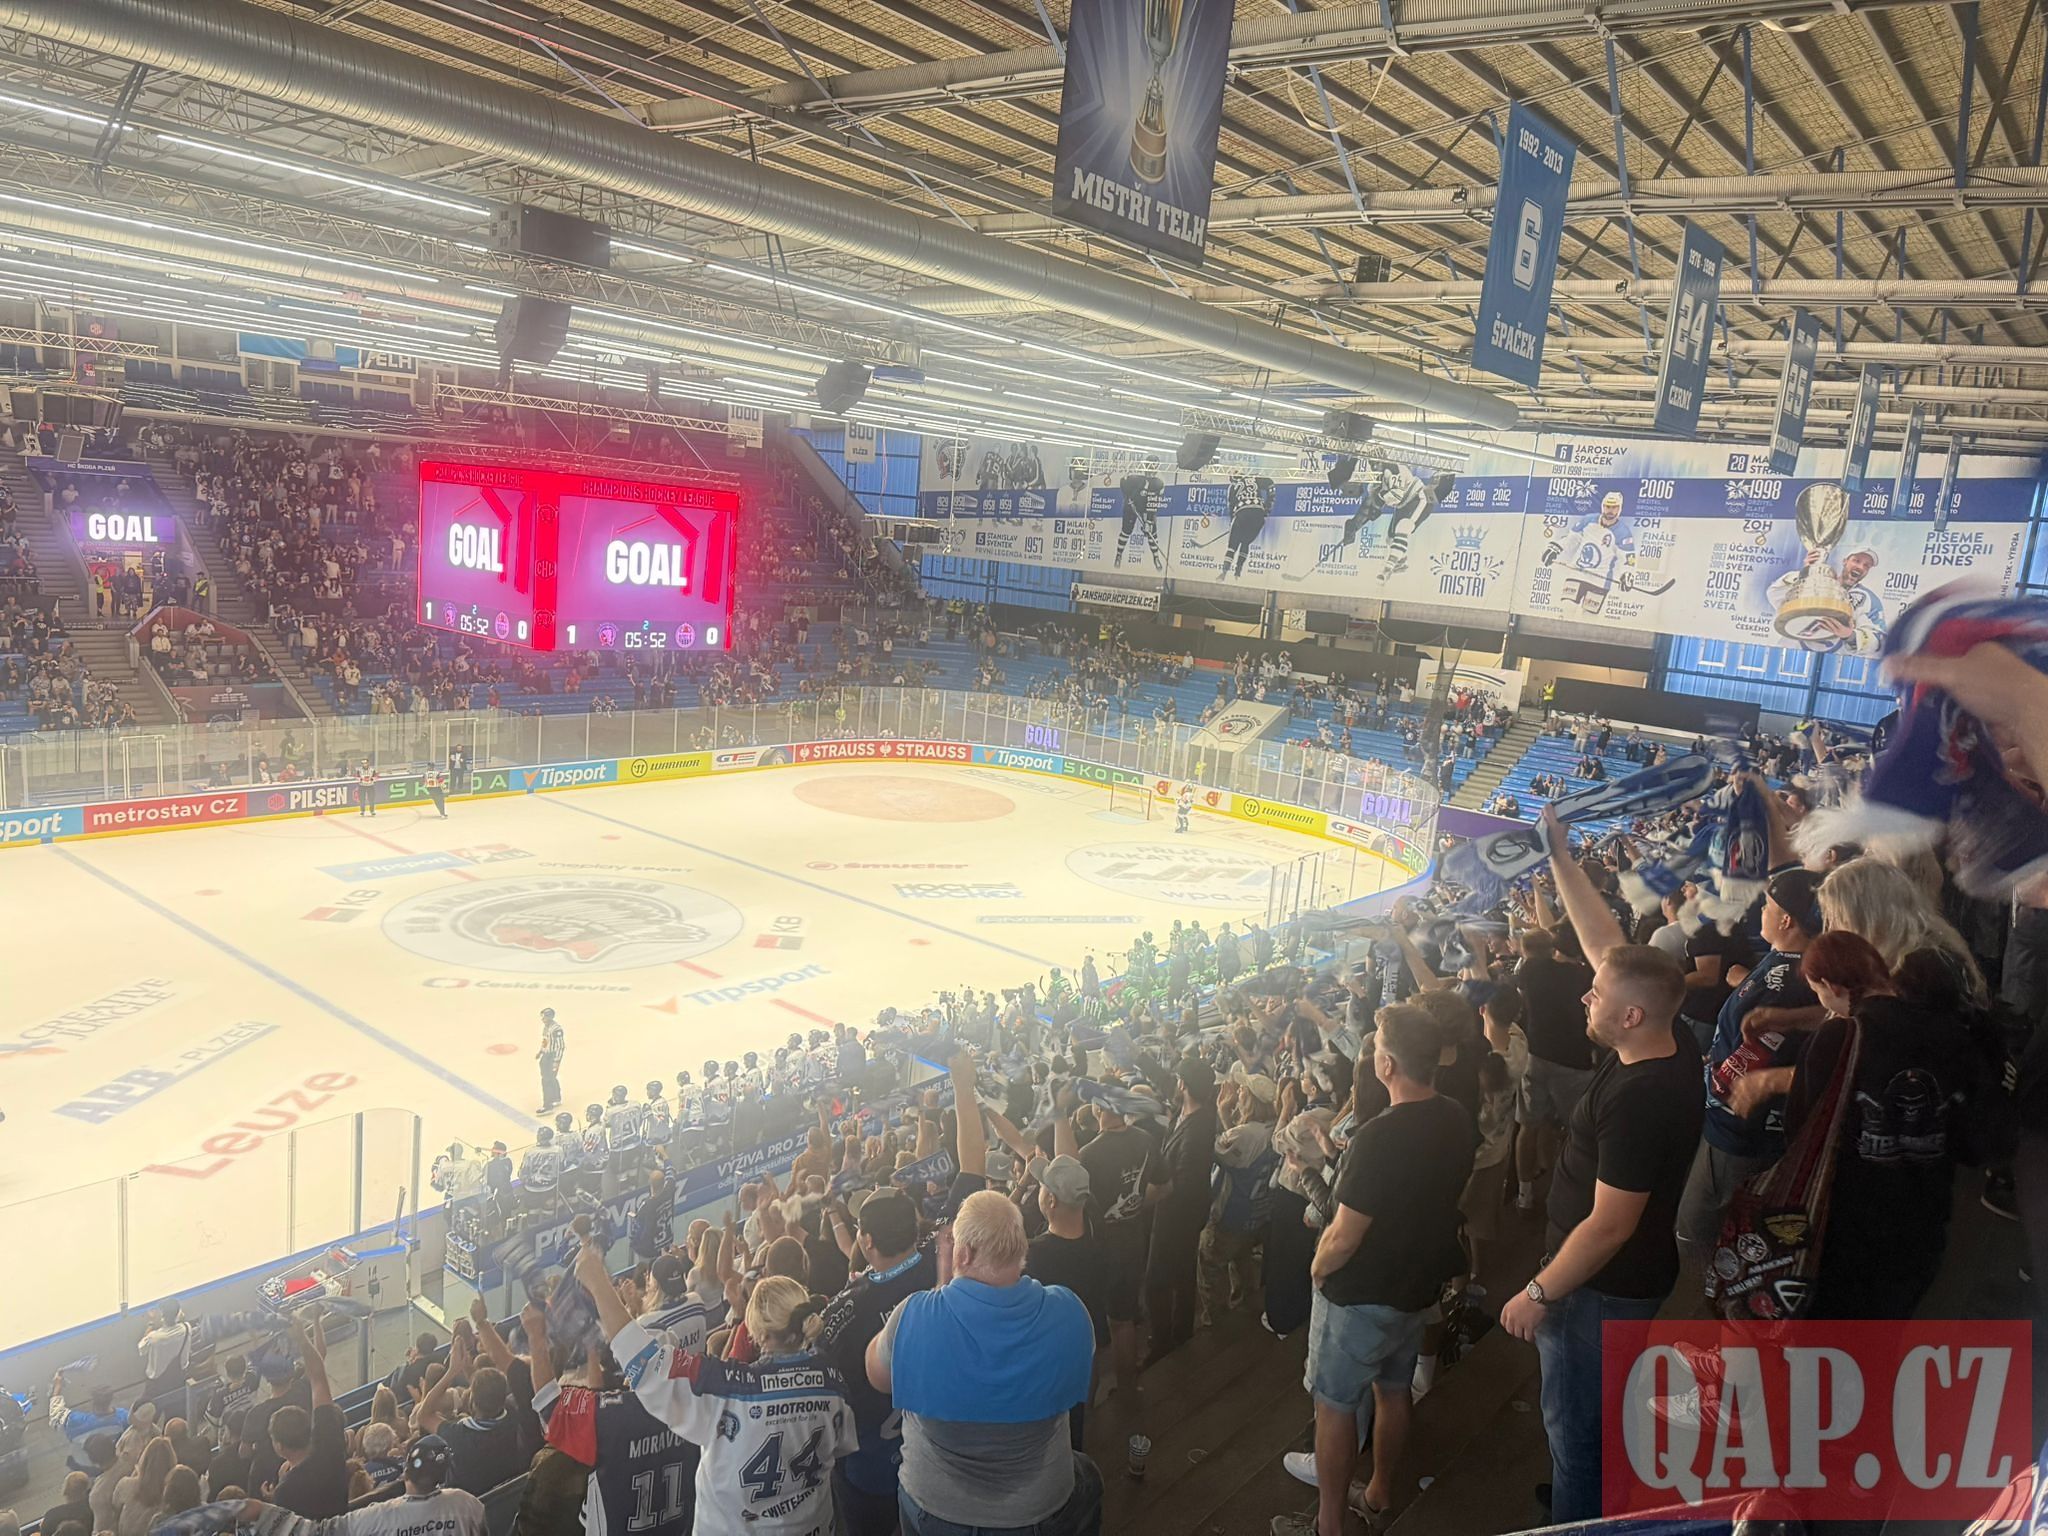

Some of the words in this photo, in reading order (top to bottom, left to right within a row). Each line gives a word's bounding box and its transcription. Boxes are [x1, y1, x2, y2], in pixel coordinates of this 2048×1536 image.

[1518, 127, 1540, 159] 1992
[1543, 145, 1564, 176] 2013
[1072, 166, 1151, 227] MISTŘI
[1156, 200, 1205, 248] TELH
[1513, 198, 1542, 292] 6
[1491, 313, 1536, 361] ŠPAČEK
[1573, 453, 1613, 466] ŠPAČEK
[1575, 445, 1628, 456] JAROSLAV
[1729, 454, 1747, 472] 28
[583, 482, 641, 500] CHAMPIONS
[682, 493, 715, 506] LEAGUE
[1312, 494, 1362, 506] MISTROVSTVÍ
[1548, 478, 1577, 499] 1998
[1639, 479, 1675, 500] 2006
[1749, 480, 1782, 500] 1998
[1863, 493, 1889, 510] 2016
[89, 512, 158, 543] GOAL
[1543, 515, 1569, 527] ZOH
[1633, 518, 1661, 529] ZOH
[1743, 520, 1772, 532] ZOH
[1642, 530, 1677, 543] FINÁLE
[449, 523, 504, 573] GOAL
[1639, 545, 1663, 559] 2006
[1729, 542, 1760, 554] ÚČAST
[1923, 543, 1993, 555] HISTORII
[606, 539, 687, 587] GOAL
[1450, 551, 1481, 572] 2013
[1725, 562, 1754, 572] SVĚTA
[1930, 555, 1973, 567] DNES
[1439, 572, 1486, 598] MISTŘI
[1706, 570, 1742, 591] 2005
[1885, 572, 1918, 590] 2004
[1703, 599, 1737, 611] SVĚTA
[1705, 588, 1739, 600] MISTR
[426, 601, 432, 620] 1
[517, 620, 528, 640] 0
[566, 624, 576, 644] 1
[624, 631, 666, 648] 05:52
[706, 626, 718, 645] 0
[1025, 724, 1061, 752] GOAL
[813, 742, 876, 759] STRAUSS
[896, 743, 967, 763] STRAUSS
[997, 750, 1054, 774] Tipsport
[541, 764, 606, 787] Tipsport
[650, 759, 700, 772] WARRIOR
[290, 786, 348, 811] PILSEN
[1362, 794, 1412, 823] GOAL
[93, 803, 204, 826] metrostav
[209, 798, 240, 816] CZ
[770, 915, 804, 933] KB
[682, 964, 832, 1006] Tipsport
[20, 977, 175, 1041] CREATIVE
[141, 1072, 358, 1181] Leuze
[717, 1149, 765, 1178] VÝŽIVA
[767, 1138, 794, 1159] PRO
[762, 1373, 824, 1390] InterCora
[740, 1425, 825, 1503] 44
[627, 1462, 684, 1532] 11
